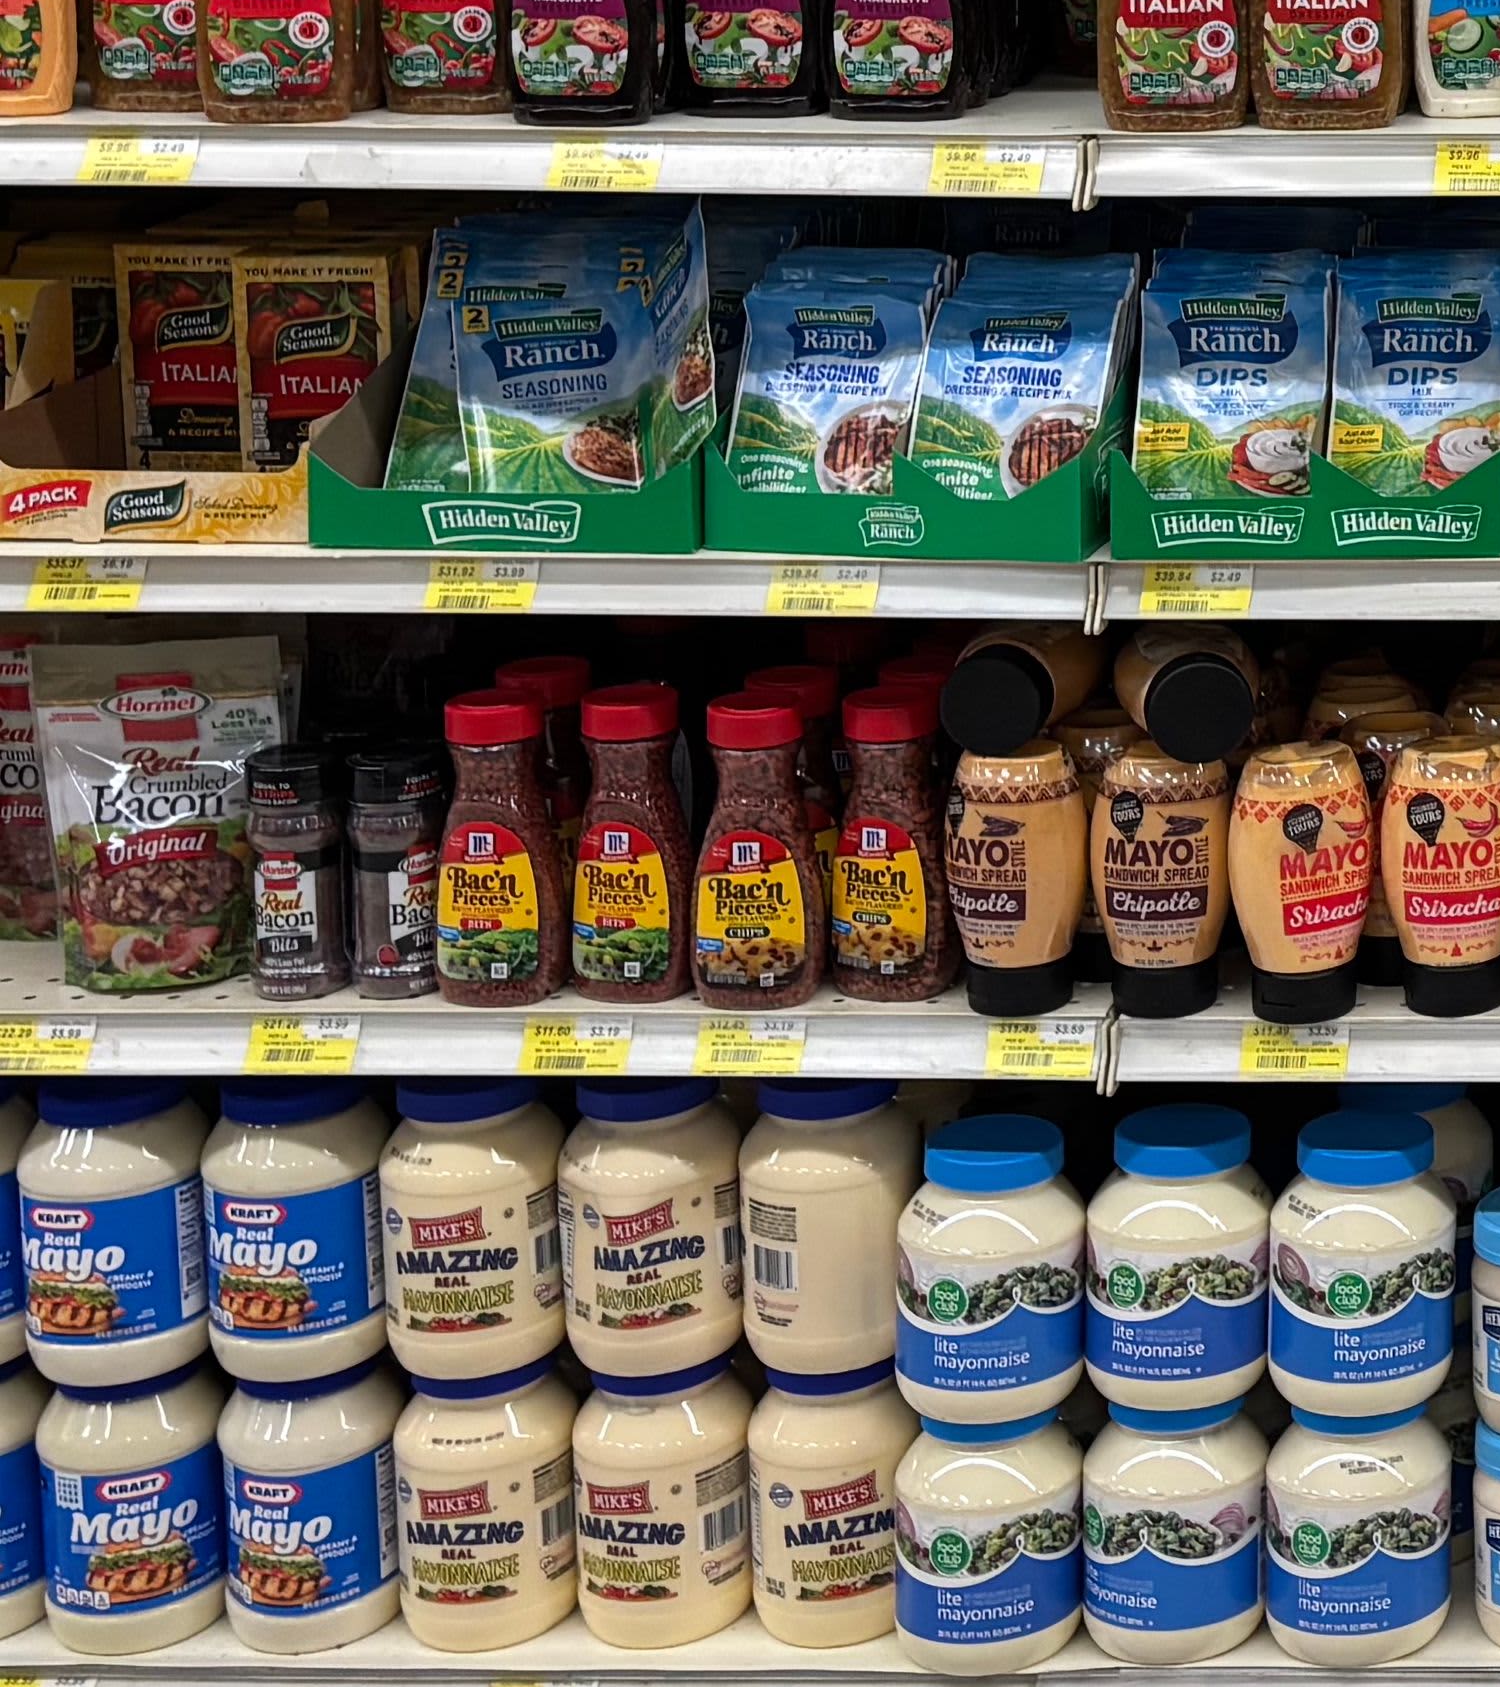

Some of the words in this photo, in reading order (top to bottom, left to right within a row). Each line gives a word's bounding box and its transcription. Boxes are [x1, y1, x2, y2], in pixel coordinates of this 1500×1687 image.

[246, 266, 272, 277] YOU
[276, 267, 304, 277] MAKE
[309, 266, 322, 277] IT
[326, 266, 373, 277] FRESH!
[502, 374, 607, 398] SEASONING
[1195, 367, 1268, 388] DIPS
[8, 490, 26, 511] 4
[29, 484, 77, 505] PACK
[121, 491, 164, 508] Good
[112, 501, 173, 520] Seasons
[439, 510, 509, 532] Hidden
[513, 509, 572, 534] Valley
[114, 696, 197, 712] Hormel
[129, 772, 228, 793] Crumbled
[107, 832, 207, 865] Original
[1104, 837, 1193, 866] MAYO
[446, 865, 523, 898] Bac'n
[1403, 870, 1462, 884] SANDWICH
[454, 888, 510, 906] Pieces
[1113, 888, 1199, 914] Chipotle
[418, 1222, 476, 1241] MIKE'S
[396, 1248, 519, 1272] AMAZING
[434, 1275, 471, 1287] REAL
[934, 1336, 958, 1354] lite
[933, 1350, 1031, 1369] mayonnaise
[105, 1476, 161, 1497] KRAFT
[70, 1500, 198, 1545] Mayo
